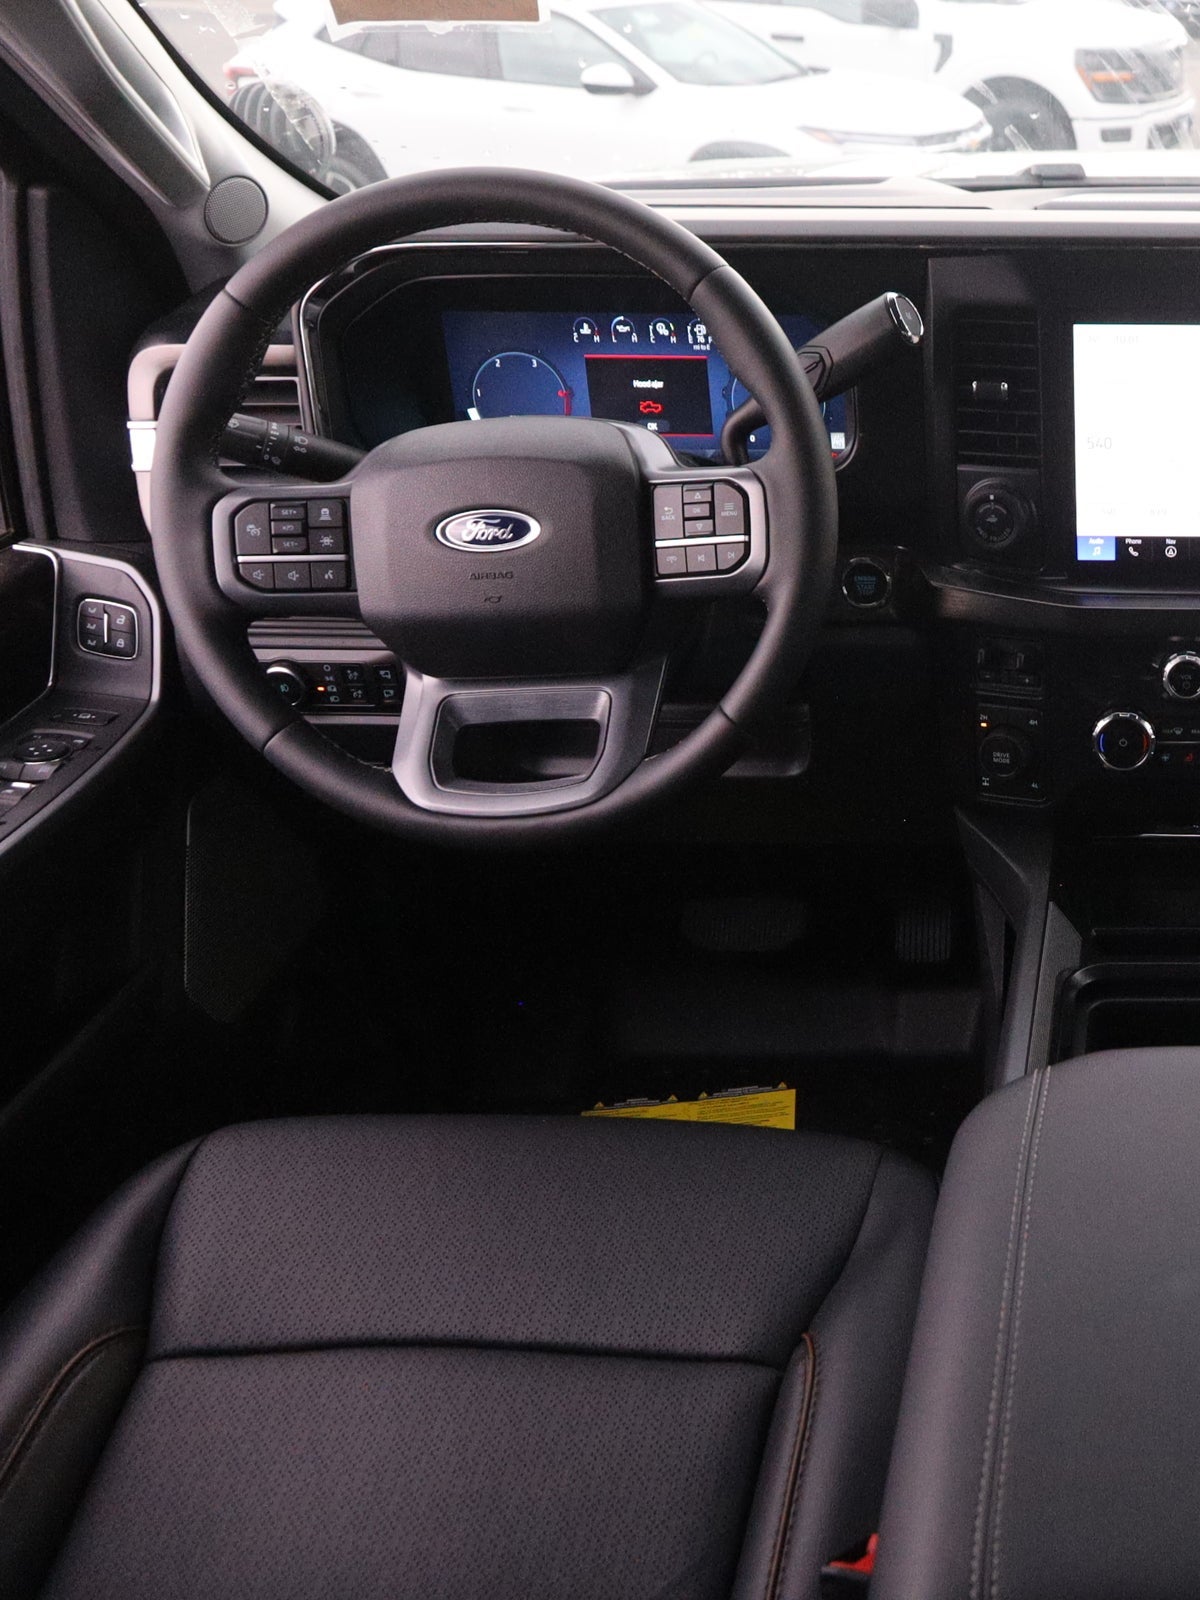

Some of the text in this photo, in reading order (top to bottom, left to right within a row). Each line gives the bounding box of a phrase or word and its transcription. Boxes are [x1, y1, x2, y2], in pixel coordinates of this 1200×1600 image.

[495, 358, 501, 368] 2
[531, 358, 538, 368] 3
[647, 422, 658, 430] OK
[461, 518, 514, 543] Ford
